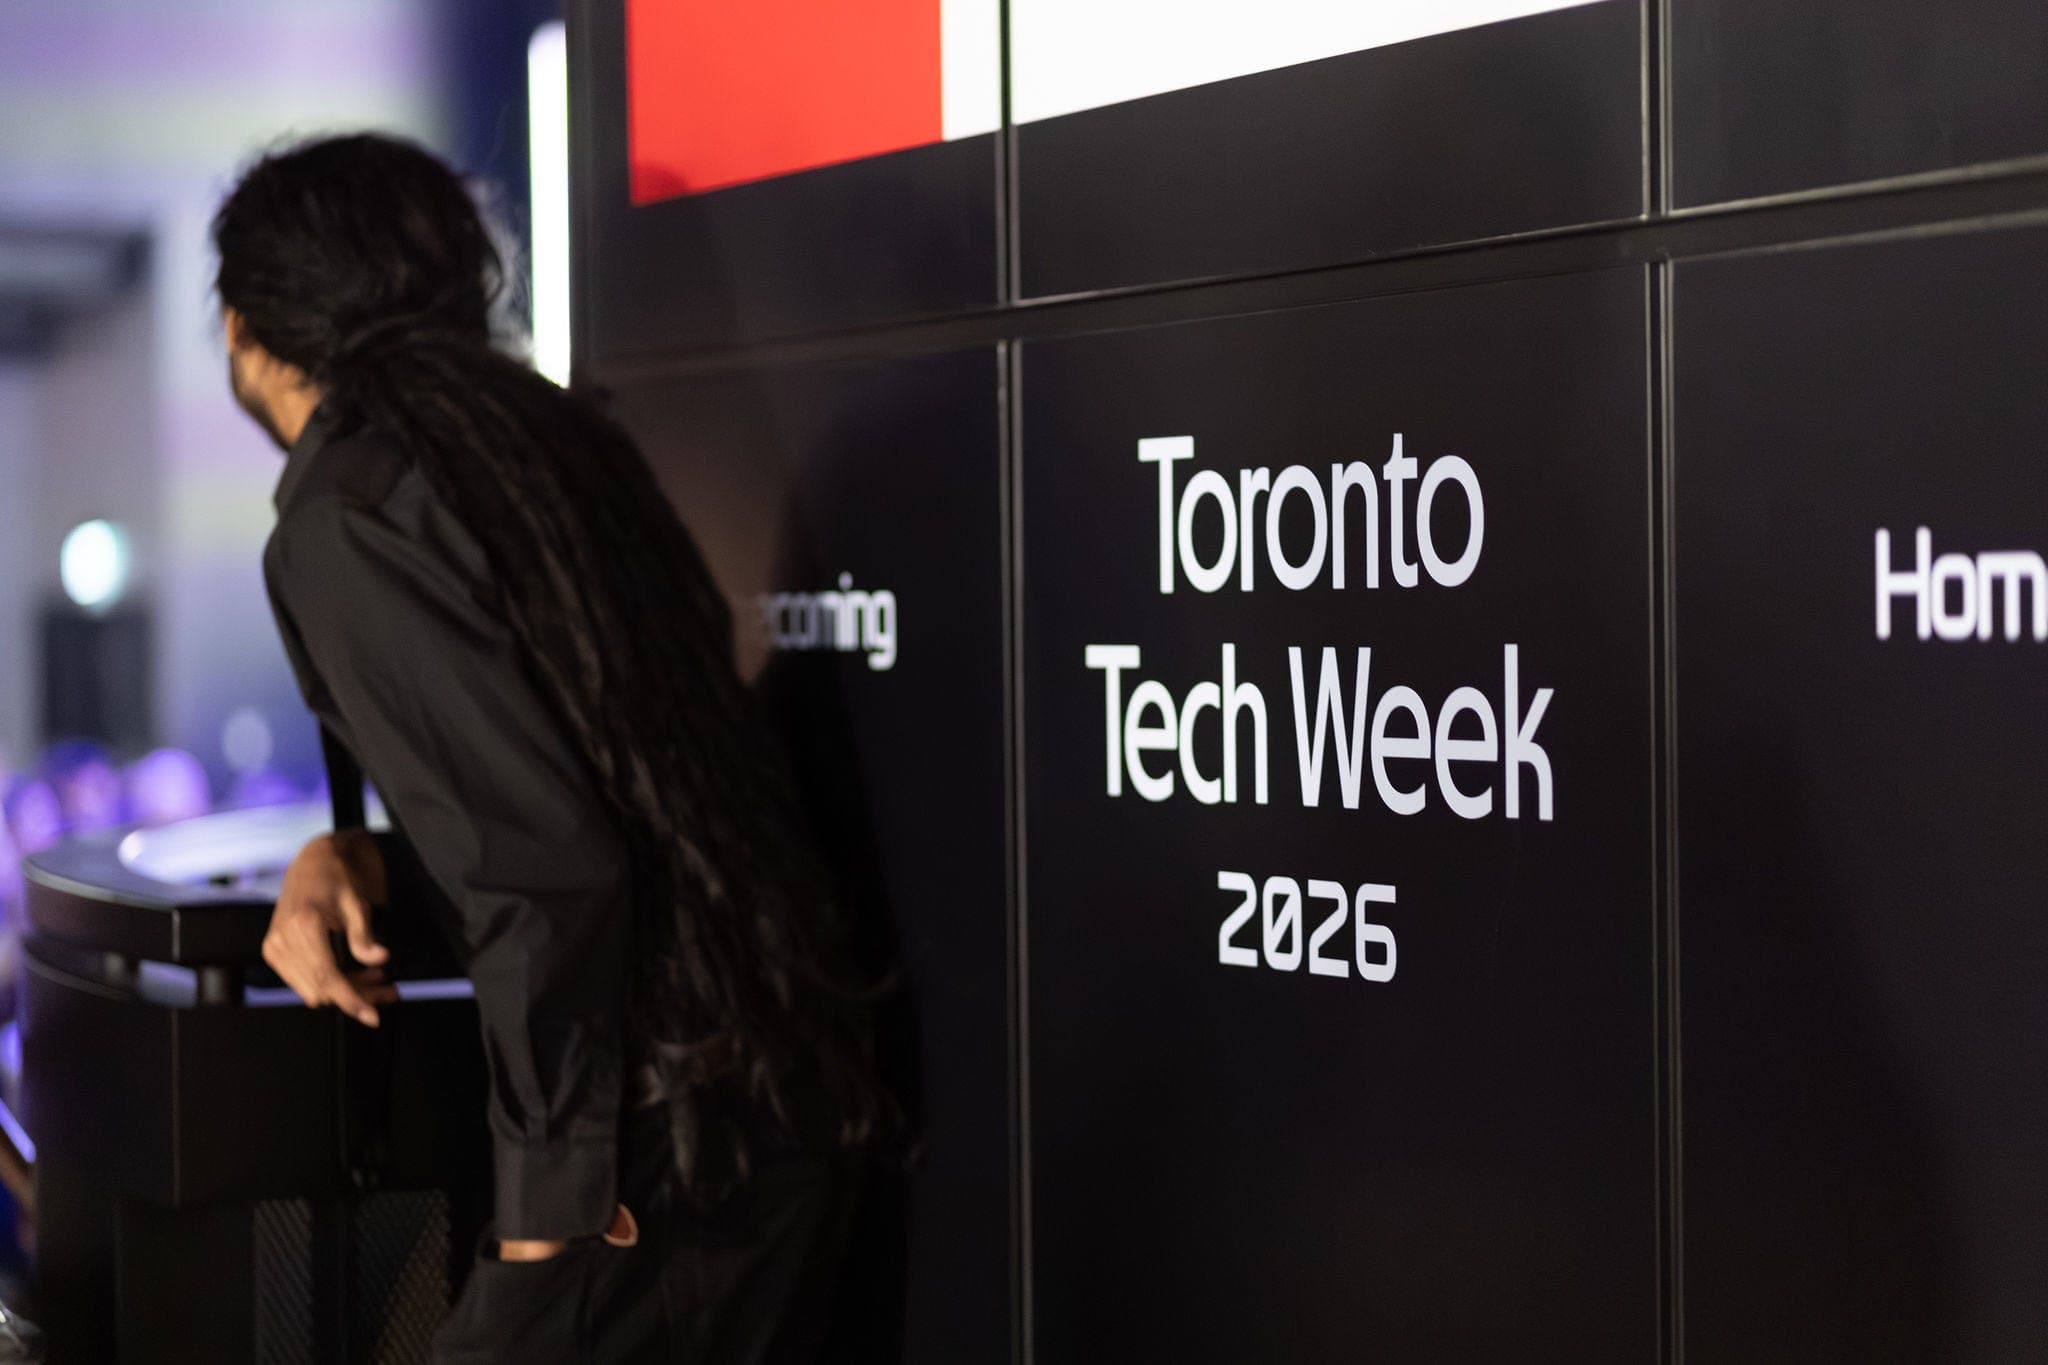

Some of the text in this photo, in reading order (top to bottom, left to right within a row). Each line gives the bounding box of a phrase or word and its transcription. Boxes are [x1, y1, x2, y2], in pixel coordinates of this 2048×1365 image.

[1137, 433, 1485, 594] Toronto
[1875, 526, 2048, 642] Hom
[1085, 643, 1554, 821] Tech Week
[1218, 871, 1397, 982] 2026
